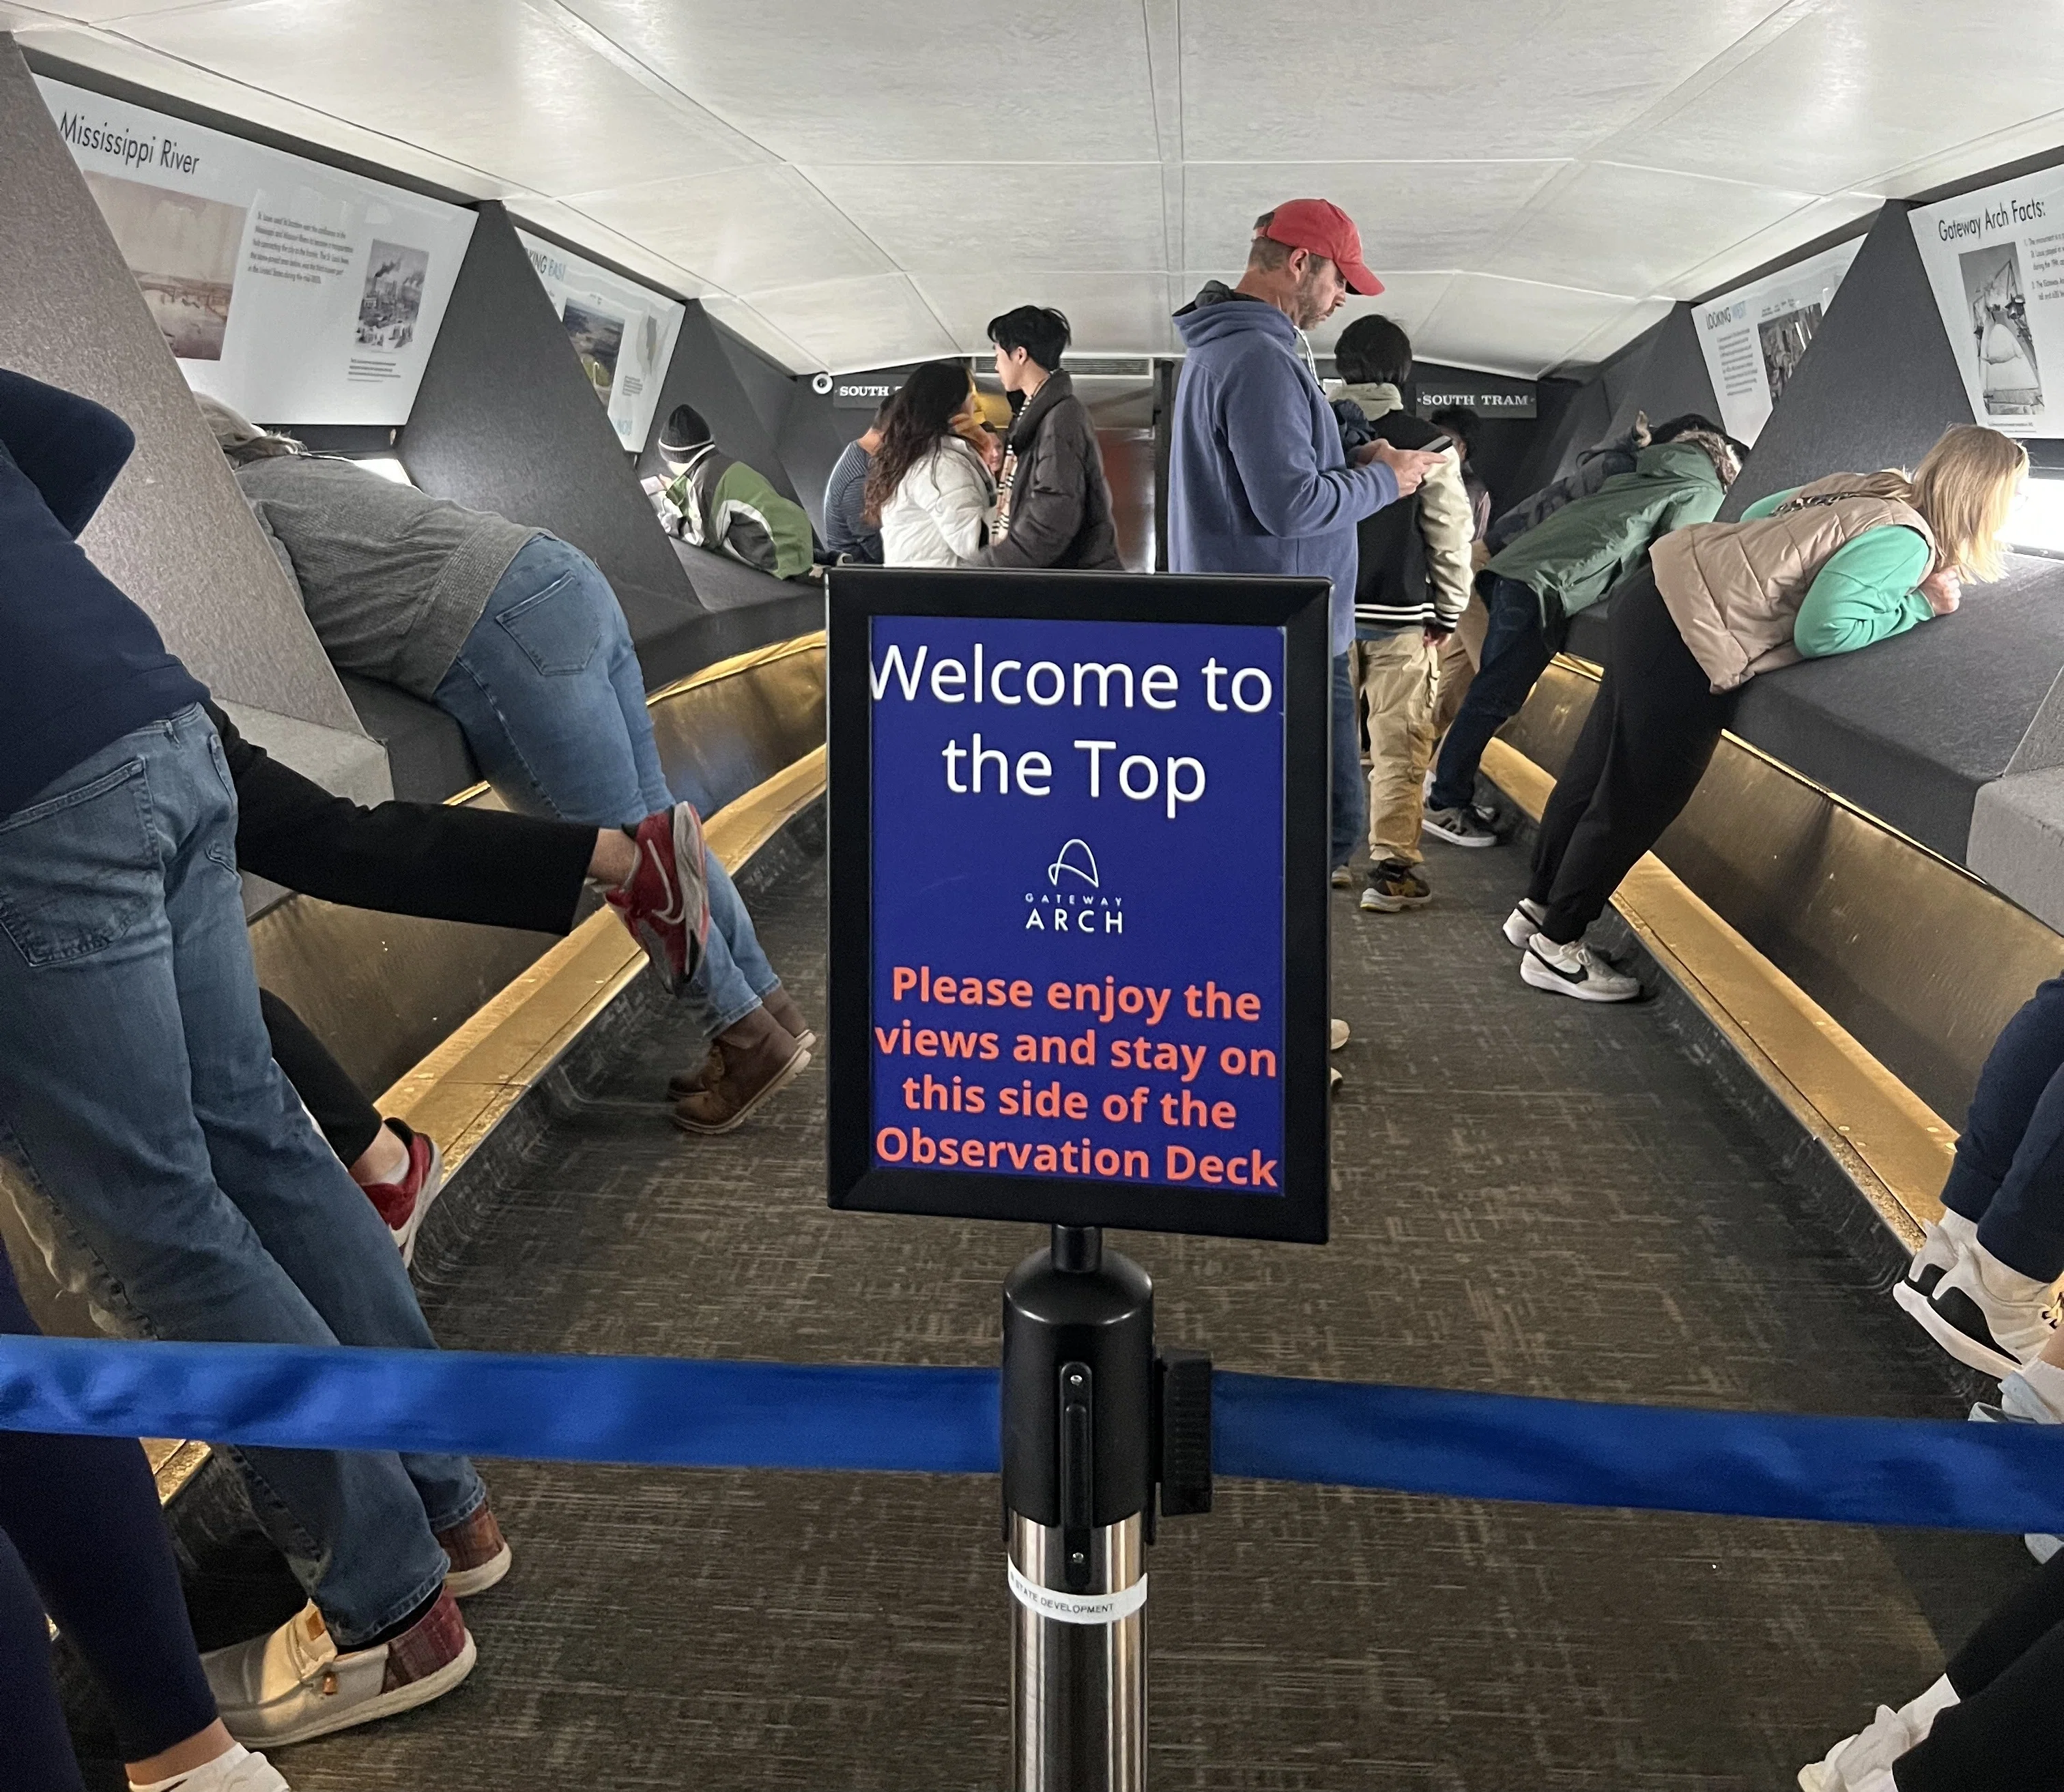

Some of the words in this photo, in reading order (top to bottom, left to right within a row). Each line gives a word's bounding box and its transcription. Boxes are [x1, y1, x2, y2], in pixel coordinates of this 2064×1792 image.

[59, 111, 156, 169] Mississippi
[160, 139, 200, 175] River
[1938, 216, 1981, 241] Gateway
[1985, 201, 2009, 231] Arch
[2011, 197, 2046, 224] Facts:
[840, 386, 889, 396] SOUTH
[1422, 394, 1475, 405] SOUTH
[1481, 394, 1528, 405] TRAM
[870, 643, 1179, 708] Welcome
[1201, 657, 1272, 713] to
[941, 733, 1052, 796] the
[1074, 740, 1206, 819] Top
[1025, 893, 1121, 907] GATEWAY
[1025, 908, 1123, 934] ARCH
[893, 966, 1033, 1007] Please
[1047, 976, 1171, 1025] enjoy
[1184, 981, 1261, 1021] the
[875, 1020, 999, 1060] views
[1013, 1029, 1095, 1065] and
[1111, 1037, 1206, 1082] stay
[1220, 1047, 1276, 1077] on
[903, 1074, 985, 1113] this
[999, 1080, 1088, 1119] side
[1102, 1086, 1149, 1123] of
[1160, 1090, 1236, 1129] the
[876, 1127, 1149, 1178] Observation
[1166, 1146, 1277, 1187] Deck
[1041, 1598, 1114, 1613] DEVELOPMENT
